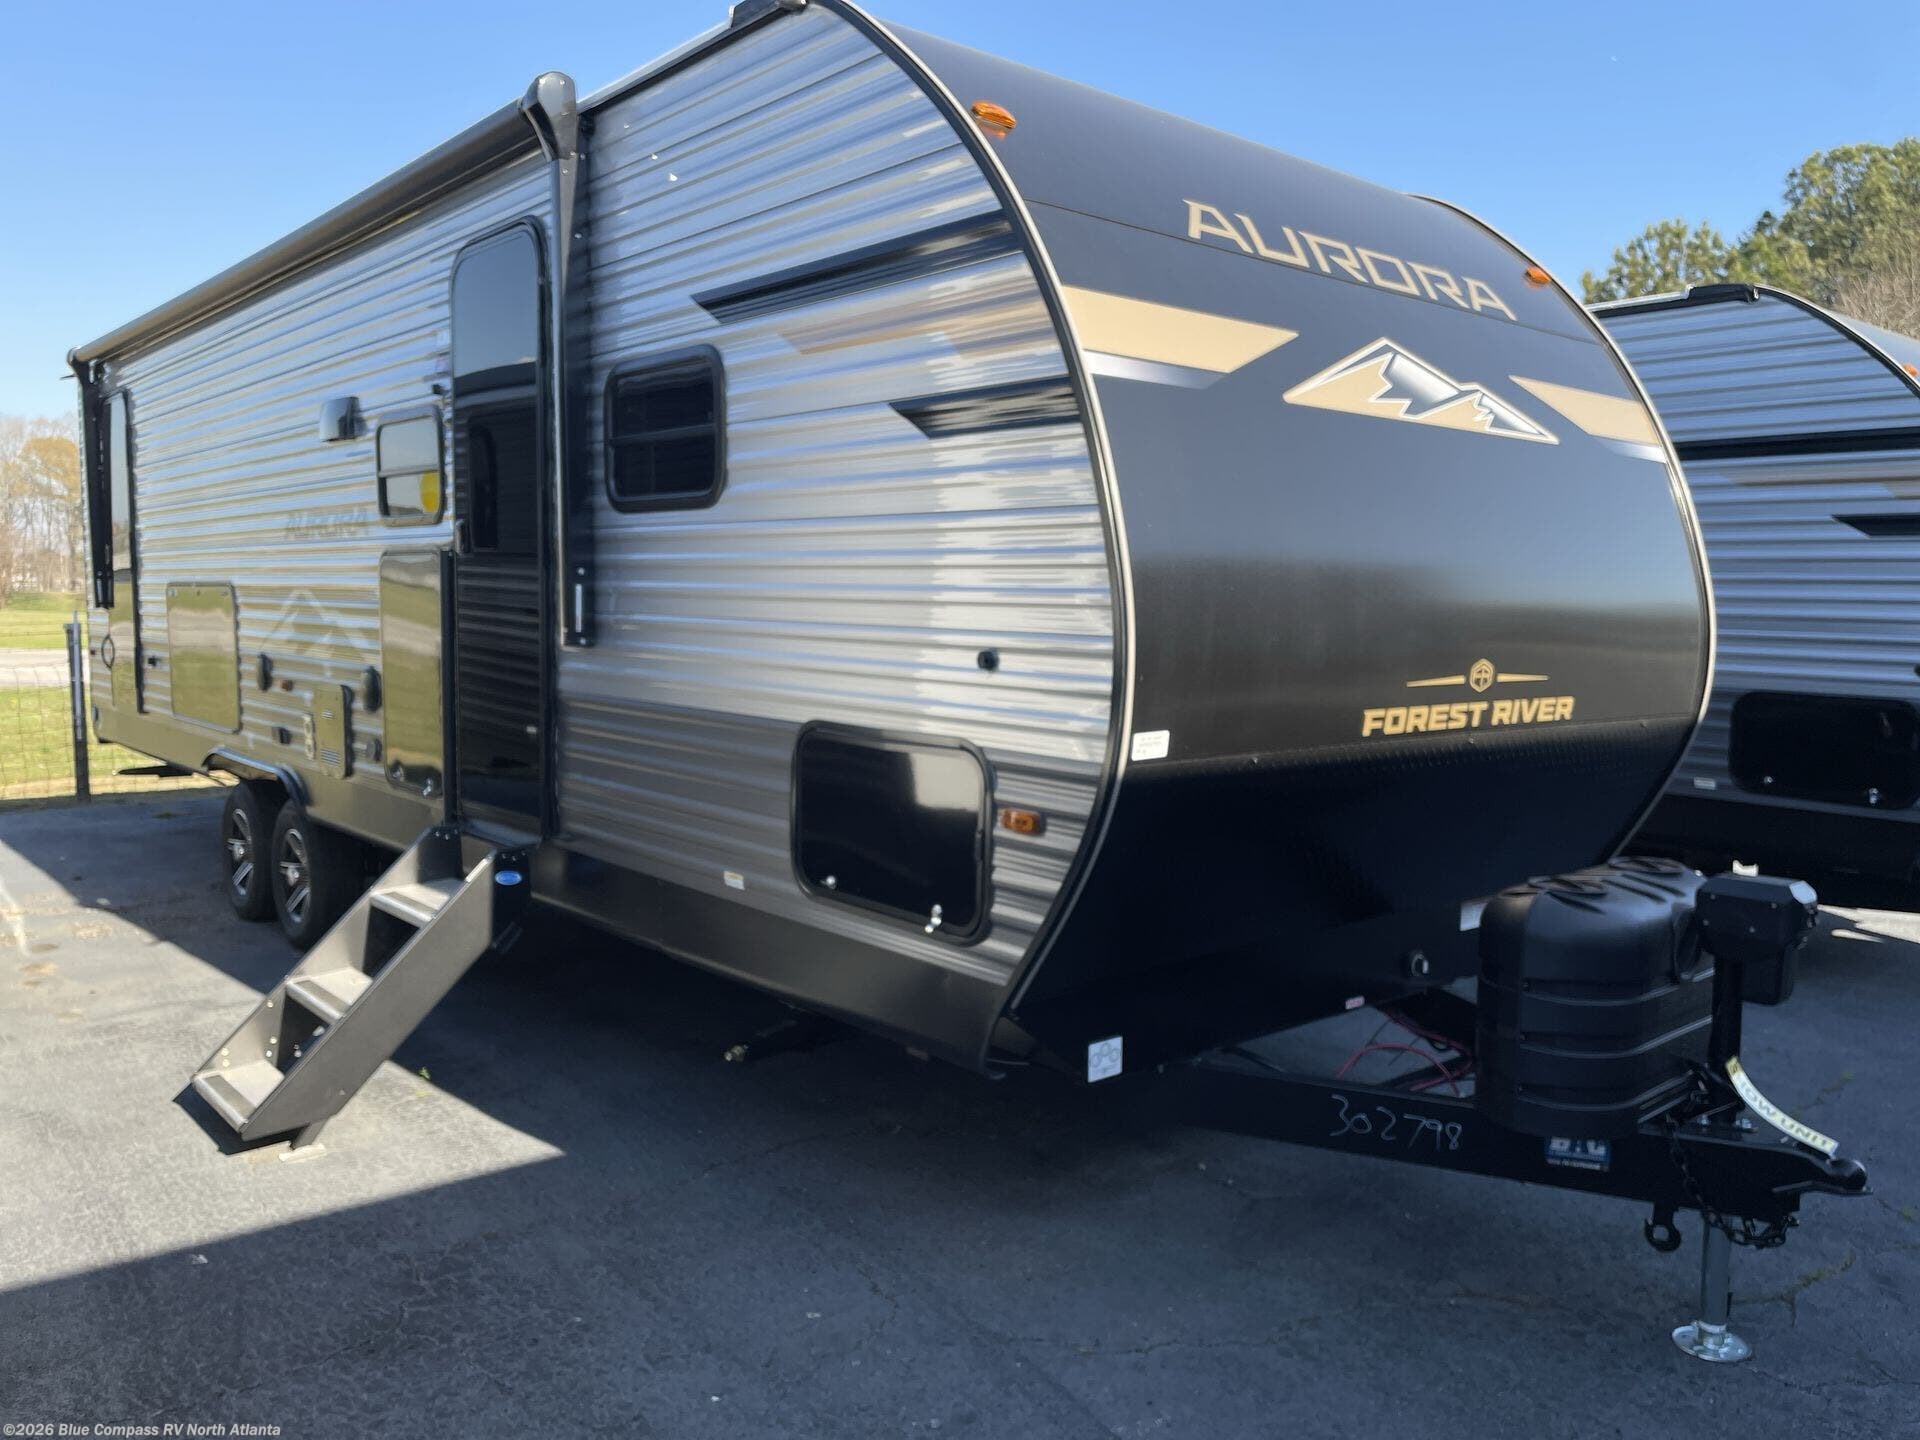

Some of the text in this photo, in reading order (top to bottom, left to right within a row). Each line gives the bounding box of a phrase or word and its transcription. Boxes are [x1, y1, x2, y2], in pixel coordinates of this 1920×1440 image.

[1182, 199, 1518, 321] AURORA
[1362, 696, 1575, 737] FOREST RIVER
[1329, 1094, 1462, 1150] 302798
